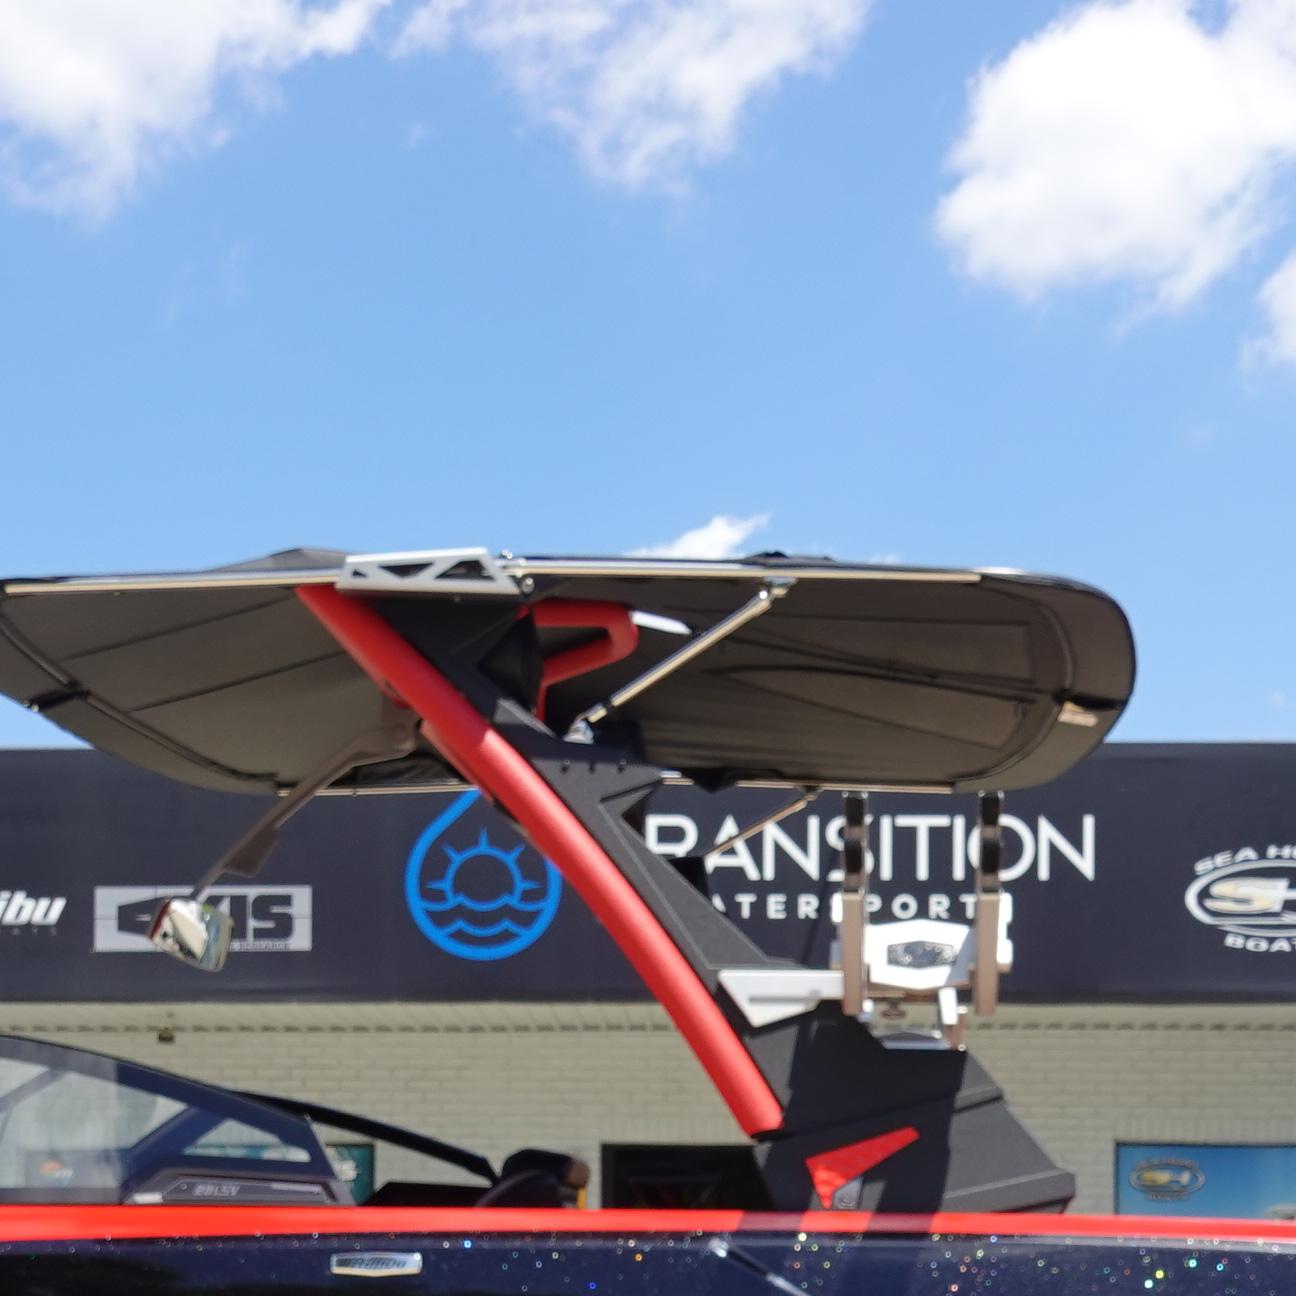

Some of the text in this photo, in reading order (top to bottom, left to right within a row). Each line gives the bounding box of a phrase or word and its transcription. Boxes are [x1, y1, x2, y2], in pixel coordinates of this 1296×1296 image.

[645, 814, 1095, 881] RANSITION
[1194, 847, 1258, 876] SEA
[117, 894, 294, 940] AIS
